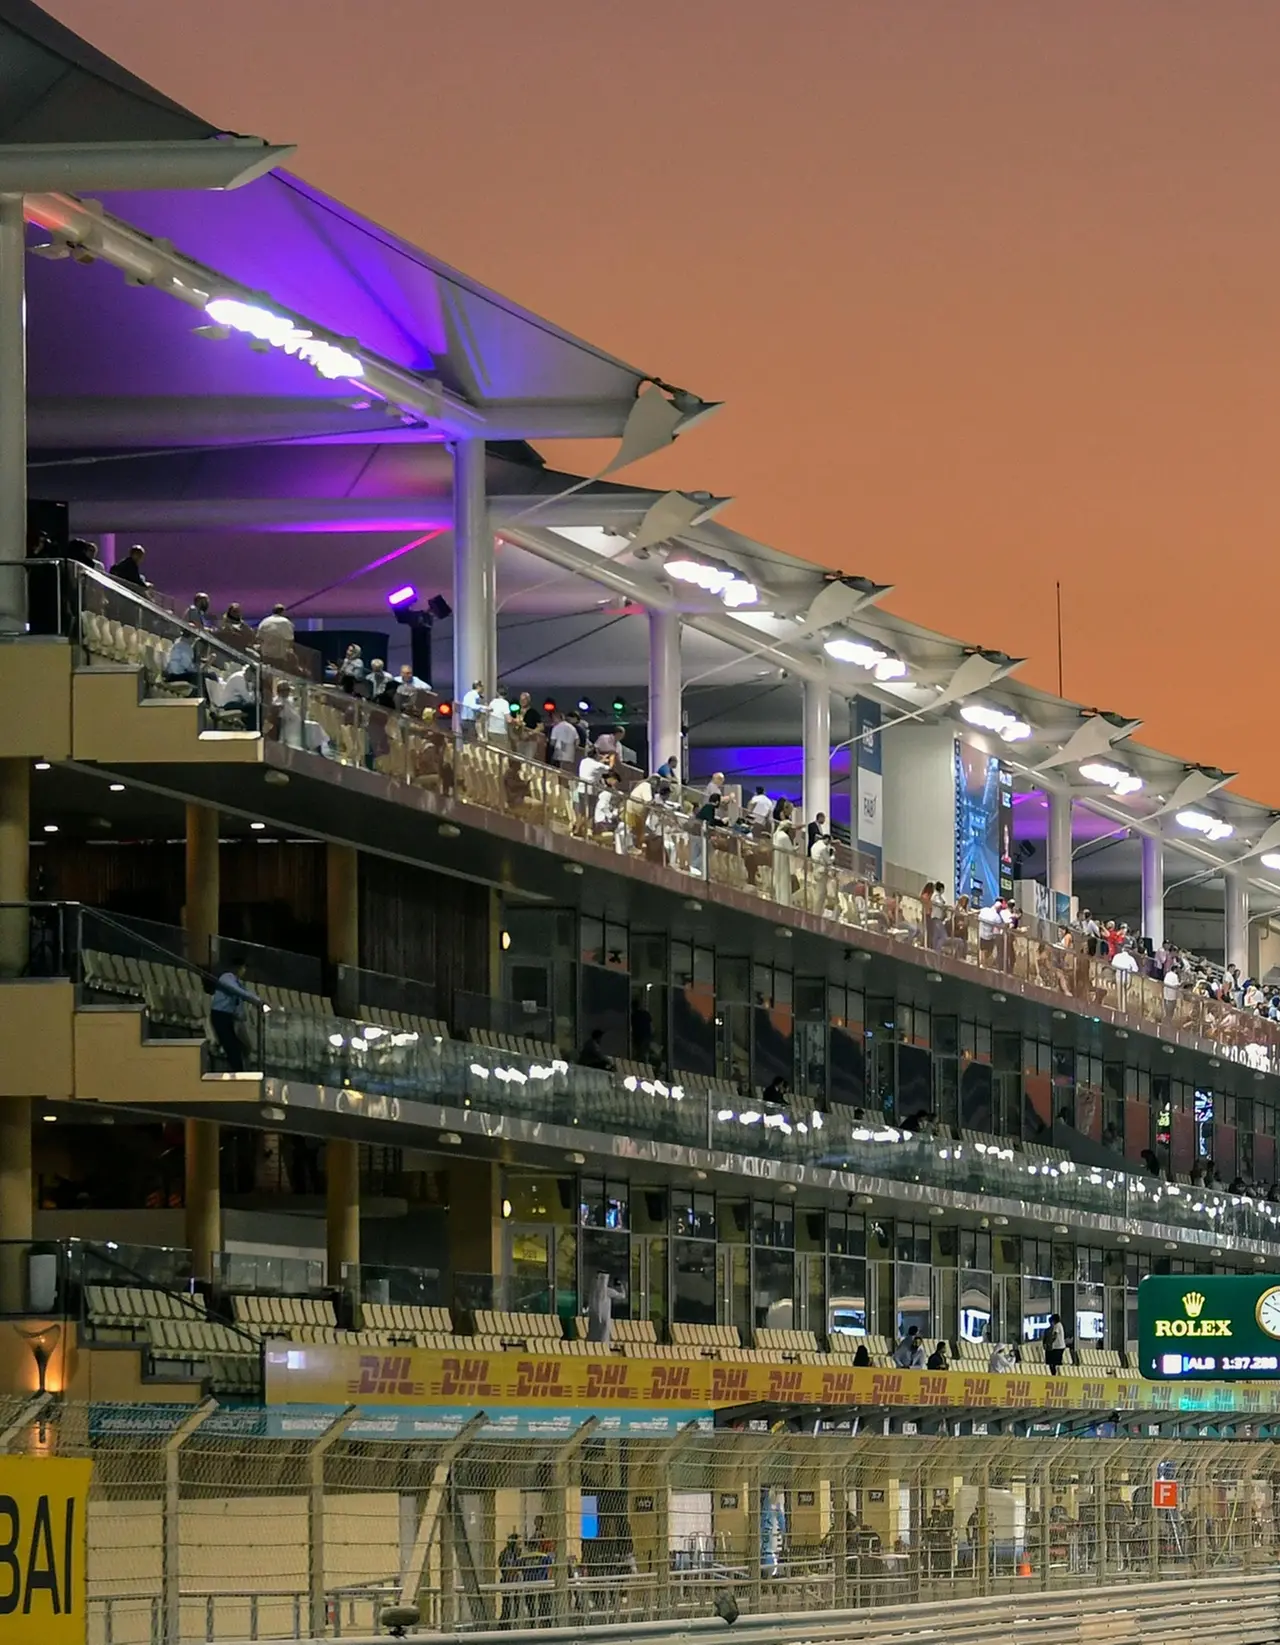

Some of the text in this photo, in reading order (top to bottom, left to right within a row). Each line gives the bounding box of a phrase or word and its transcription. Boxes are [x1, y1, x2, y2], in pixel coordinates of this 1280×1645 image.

[1155, 1319, 1233, 1337] ROLEX
[359, 1355, 414, 1395] DHL
[442, 1358, 491, 1396] DHL
[517, 1361, 563, 1397] DHL
[587, 1364, 631, 1398] DHL
[652, 1366, 692, 1399] DHL
[712, 1368, 750, 1400] DHL
[769, 1371, 806, 1400] DHL
[822, 1373, 855, 1403] DHL
[873, 1374, 904, 1404] DHL
[919, 1376, 949, 1405] DHL
[963, 1378, 991, 1406] DHL
[1006, 1380, 1032, 1407] DHL
[1045, 1381, 1070, 1407] DHL
[1160, 1484, 1171, 1504] F
[0, 1495, 75, 1614] BAI
